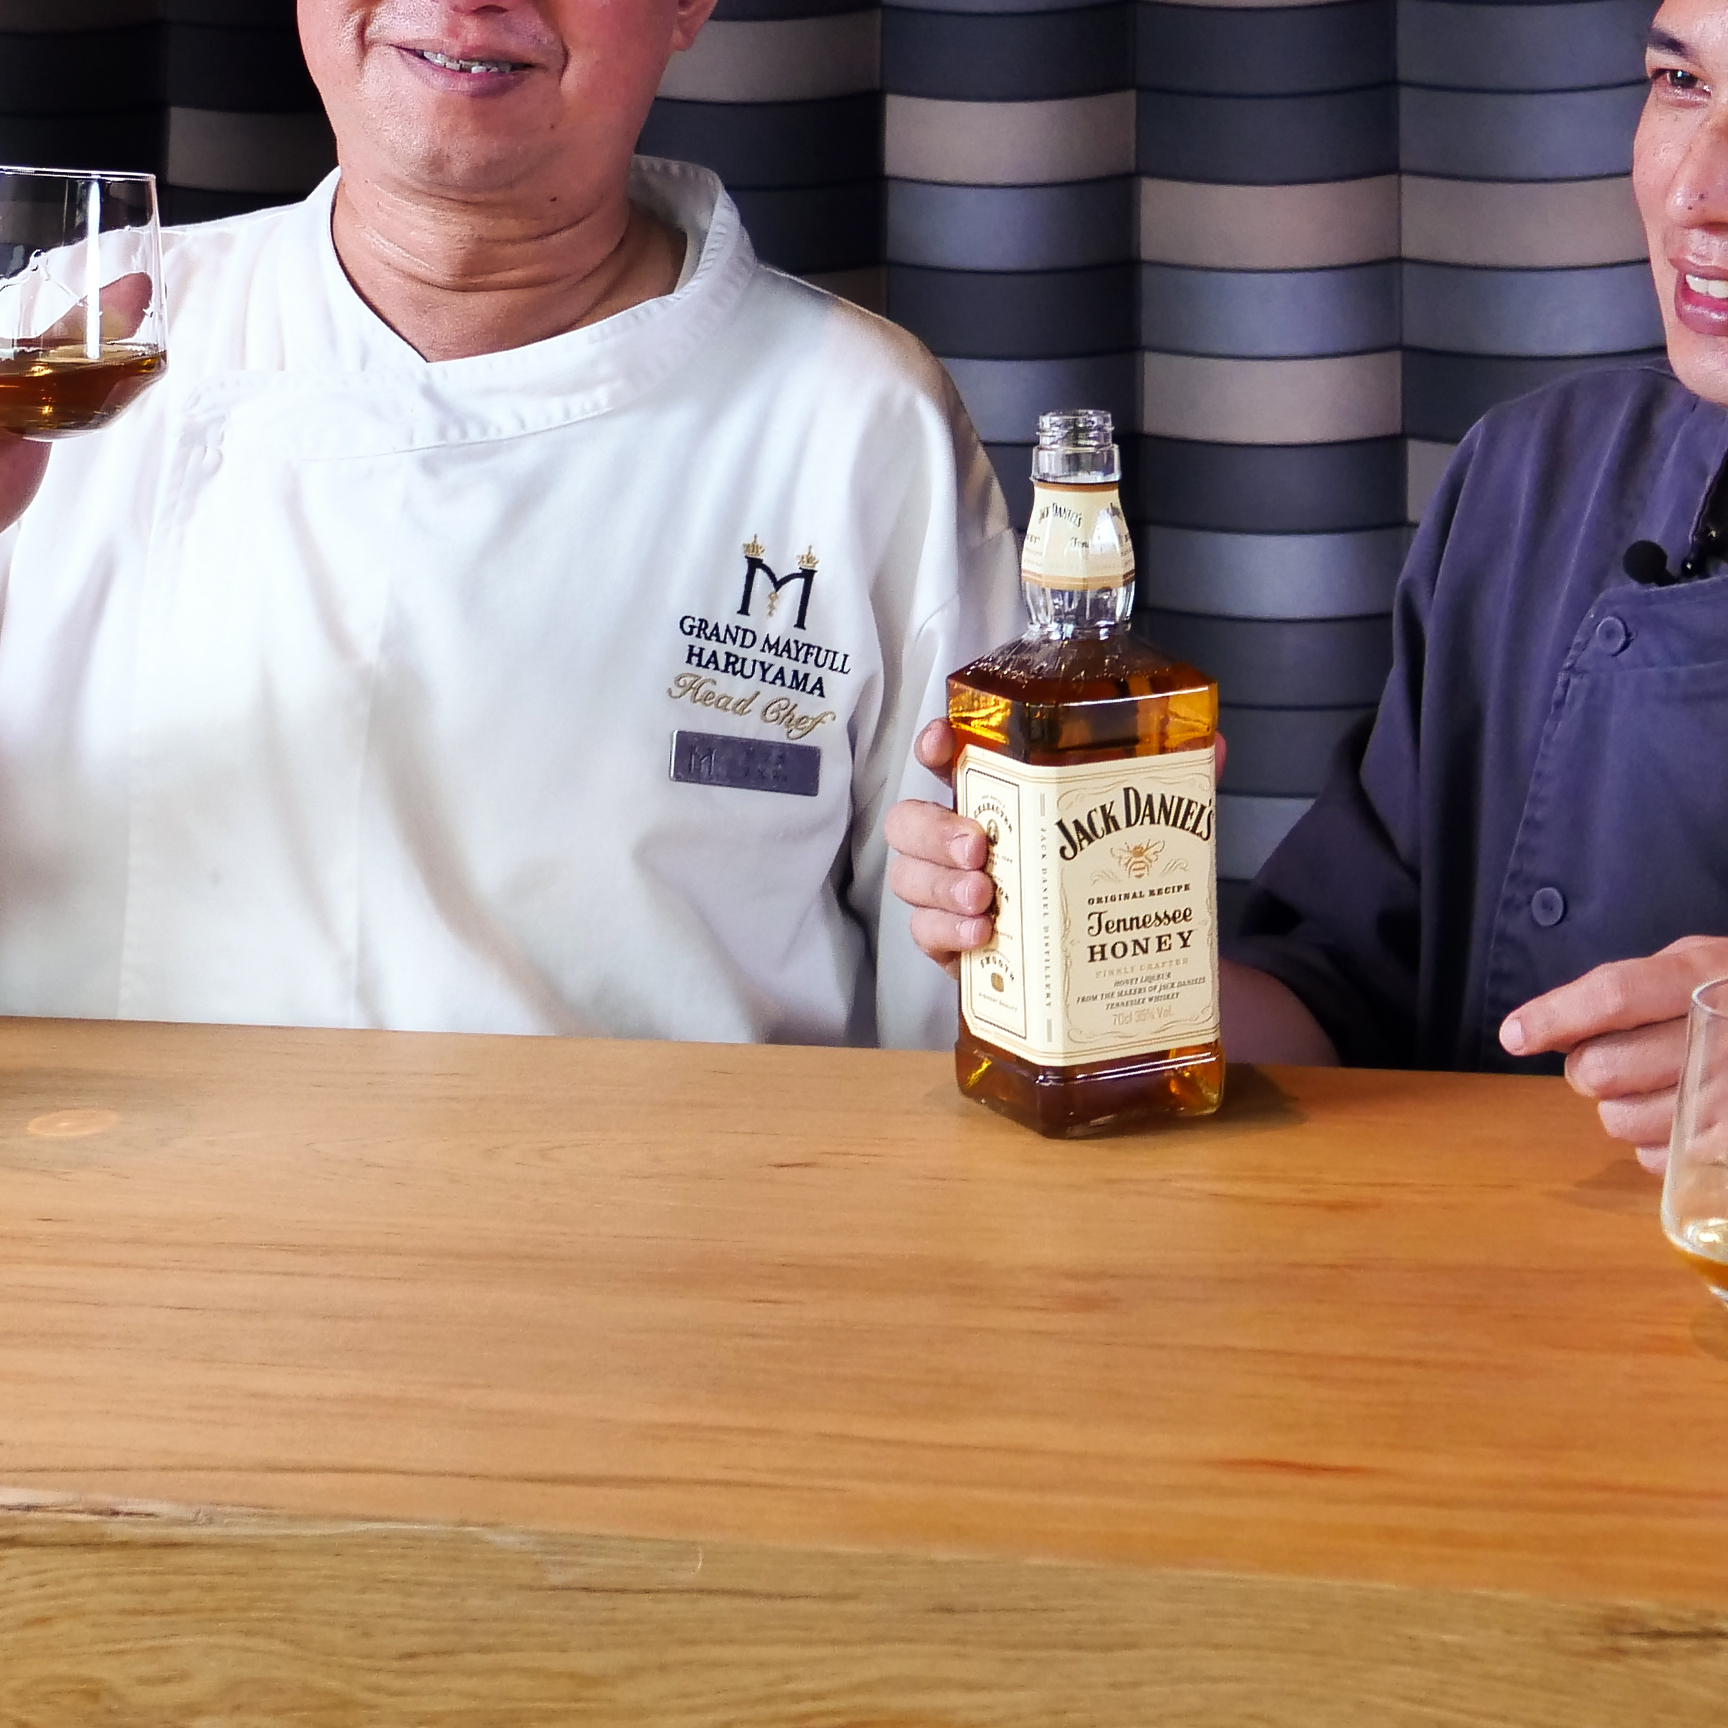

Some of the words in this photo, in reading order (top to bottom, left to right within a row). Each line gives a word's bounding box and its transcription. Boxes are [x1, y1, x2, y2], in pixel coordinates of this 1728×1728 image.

[679, 614, 757, 650] GRAND
[760, 633, 851, 675] MAYFULL
[685, 644, 826, 698] HARUYAMA
[667, 672, 761, 717] Head
[760, 696, 836, 741] Chef
[1055, 800, 1121, 861] JACK
[1123, 786, 1213, 841] DANIEL'S
[1087, 906, 1193, 937] Tennessee
[1088, 891, 1145, 906] ORIGINAL
[1148, 883, 1191, 897] RECIPE
[1087, 930, 1193, 963] HONEY
